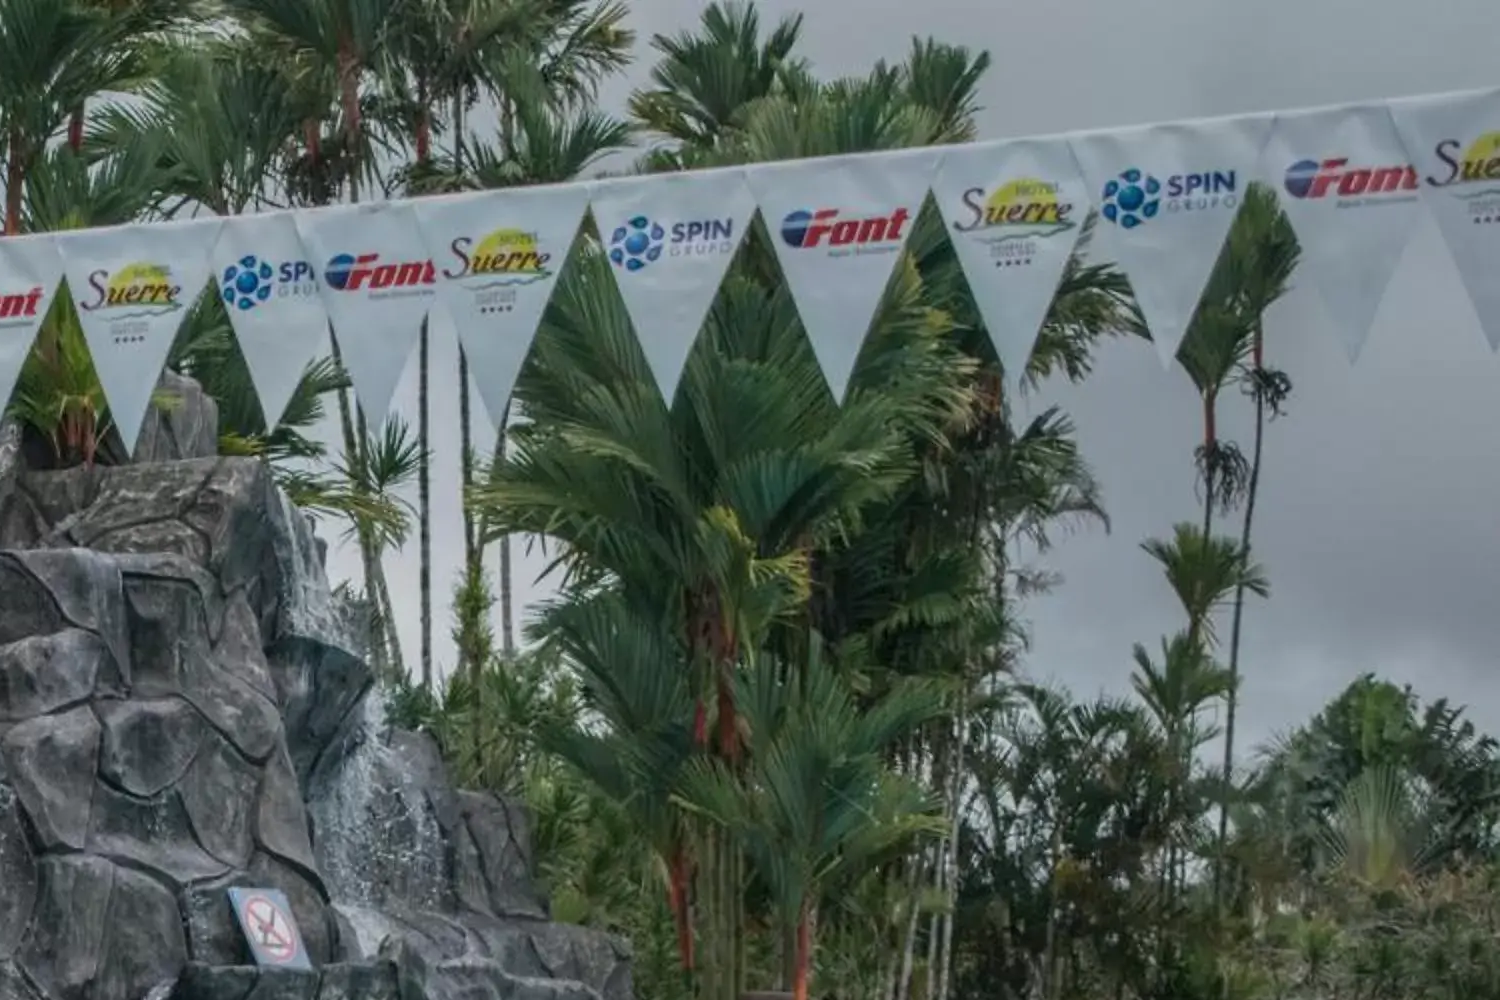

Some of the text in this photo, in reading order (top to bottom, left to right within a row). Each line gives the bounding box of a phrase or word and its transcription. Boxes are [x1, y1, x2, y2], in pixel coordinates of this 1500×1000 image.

[1167, 170, 1236, 197] SPIN
[1426, 139, 1500, 187] Sue
[953, 187, 1072, 232] Suerre
[1167, 195, 1236, 213] GRUPO
[671, 217, 732, 243] SPIN
[802, 207, 908, 248] Font
[442, 237, 551, 279] Suerre
[670, 241, 732, 257] GRUPO
[80, 269, 181, 311] Suerre
